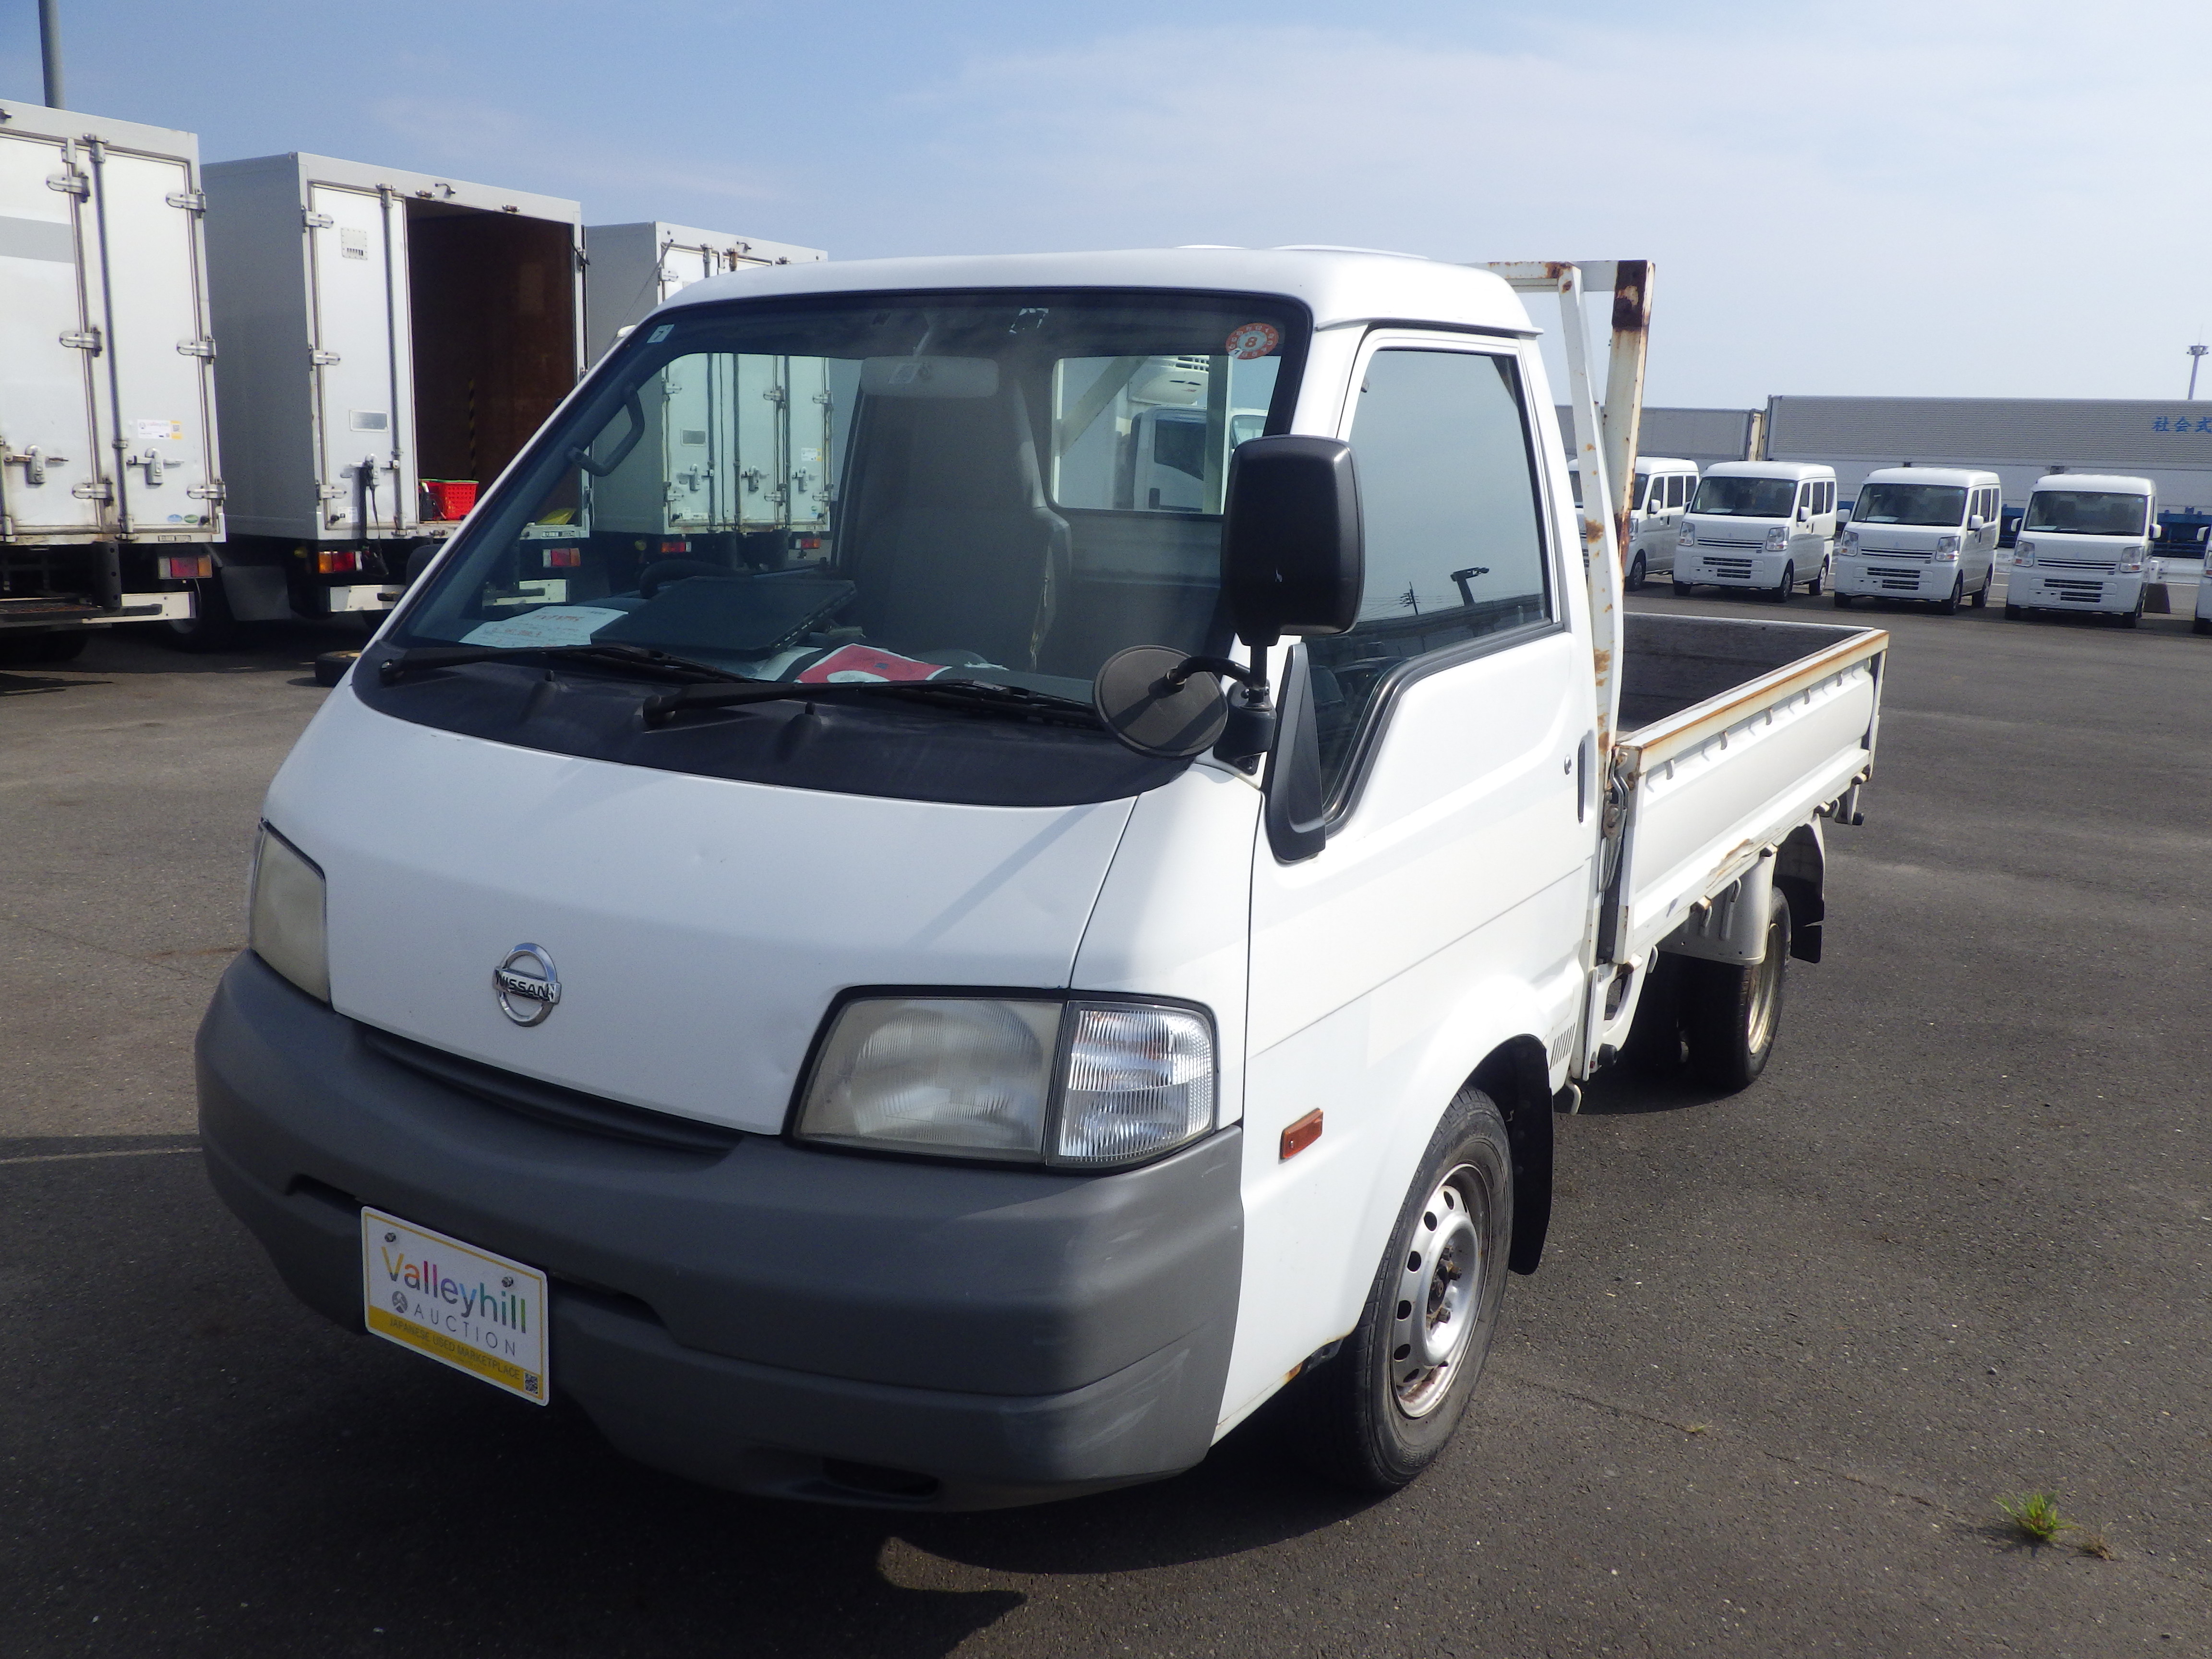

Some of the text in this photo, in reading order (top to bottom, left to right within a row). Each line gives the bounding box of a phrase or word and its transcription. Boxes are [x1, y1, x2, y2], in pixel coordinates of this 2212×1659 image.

[1245, 337, 1257, 347] 8
[496, 973, 550, 999] NISSAN
[381, 1246, 526, 1334] Valleyhill
[390, 1319, 430, 1342] JAPANESE
[433, 1334, 456, 1351] USED
[457, 1345, 520, 1380] MARKETPLACE
[414, 1304, 516, 1356] AUCTION
